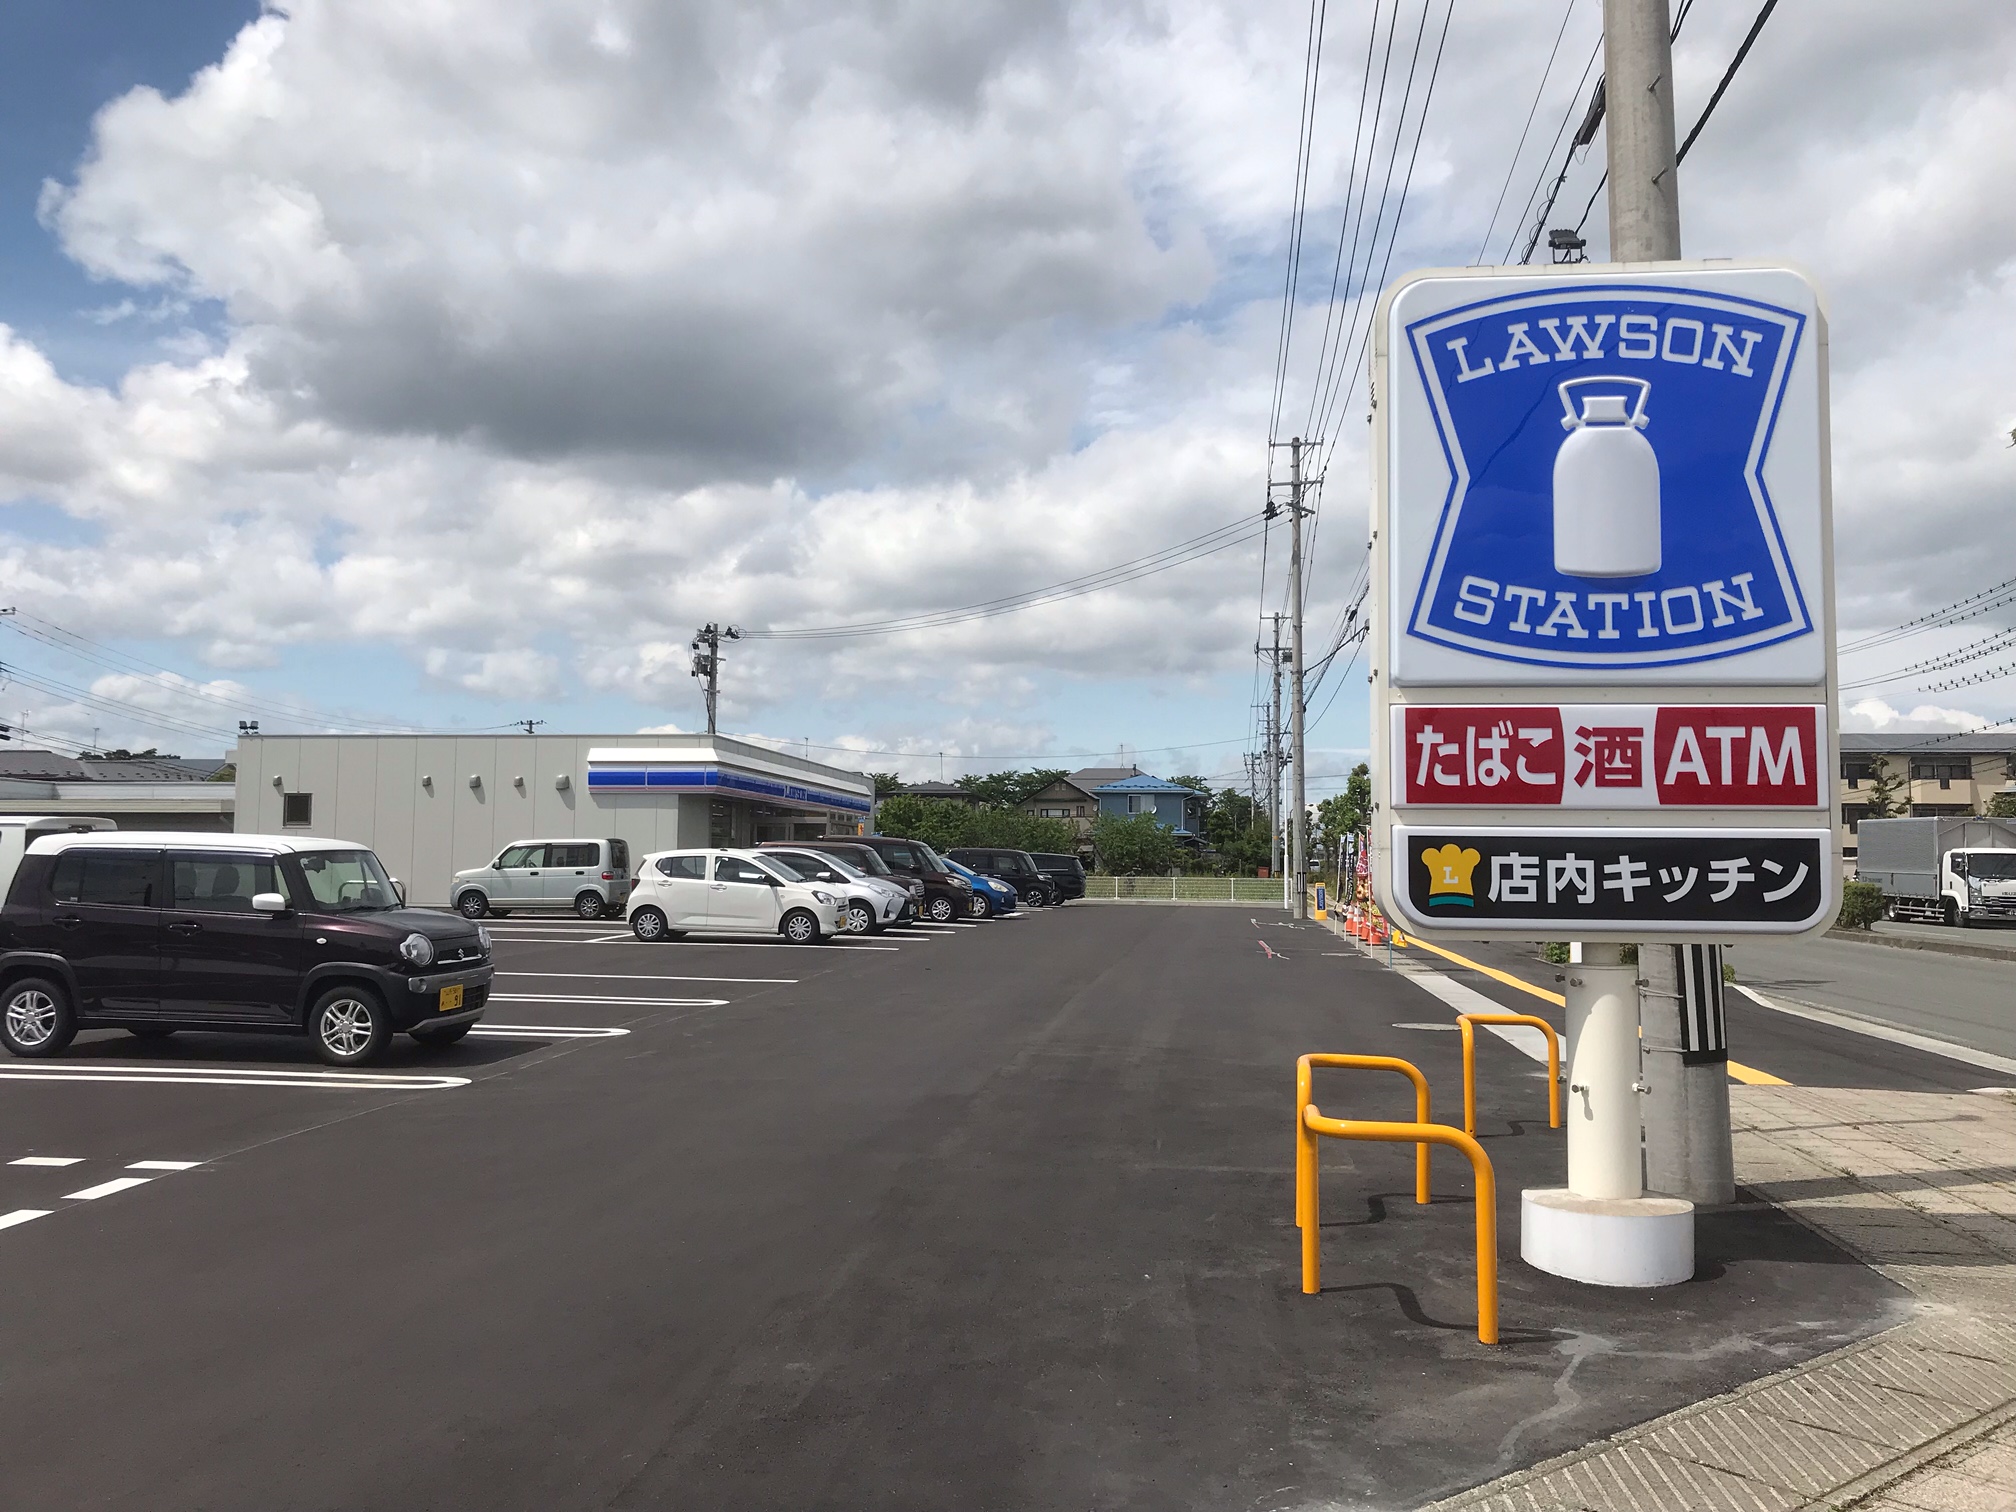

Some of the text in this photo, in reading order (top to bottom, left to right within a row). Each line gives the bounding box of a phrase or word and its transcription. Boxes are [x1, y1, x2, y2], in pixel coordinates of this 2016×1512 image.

[1446, 314, 1763, 383] LAWSON
[1454, 571, 1764, 640] STATION
[1415, 720, 1806, 788] たばこ 酒 ATM
[1443, 866, 1459, 886] L
[1487, 851, 1809, 904] 店内キッチン
